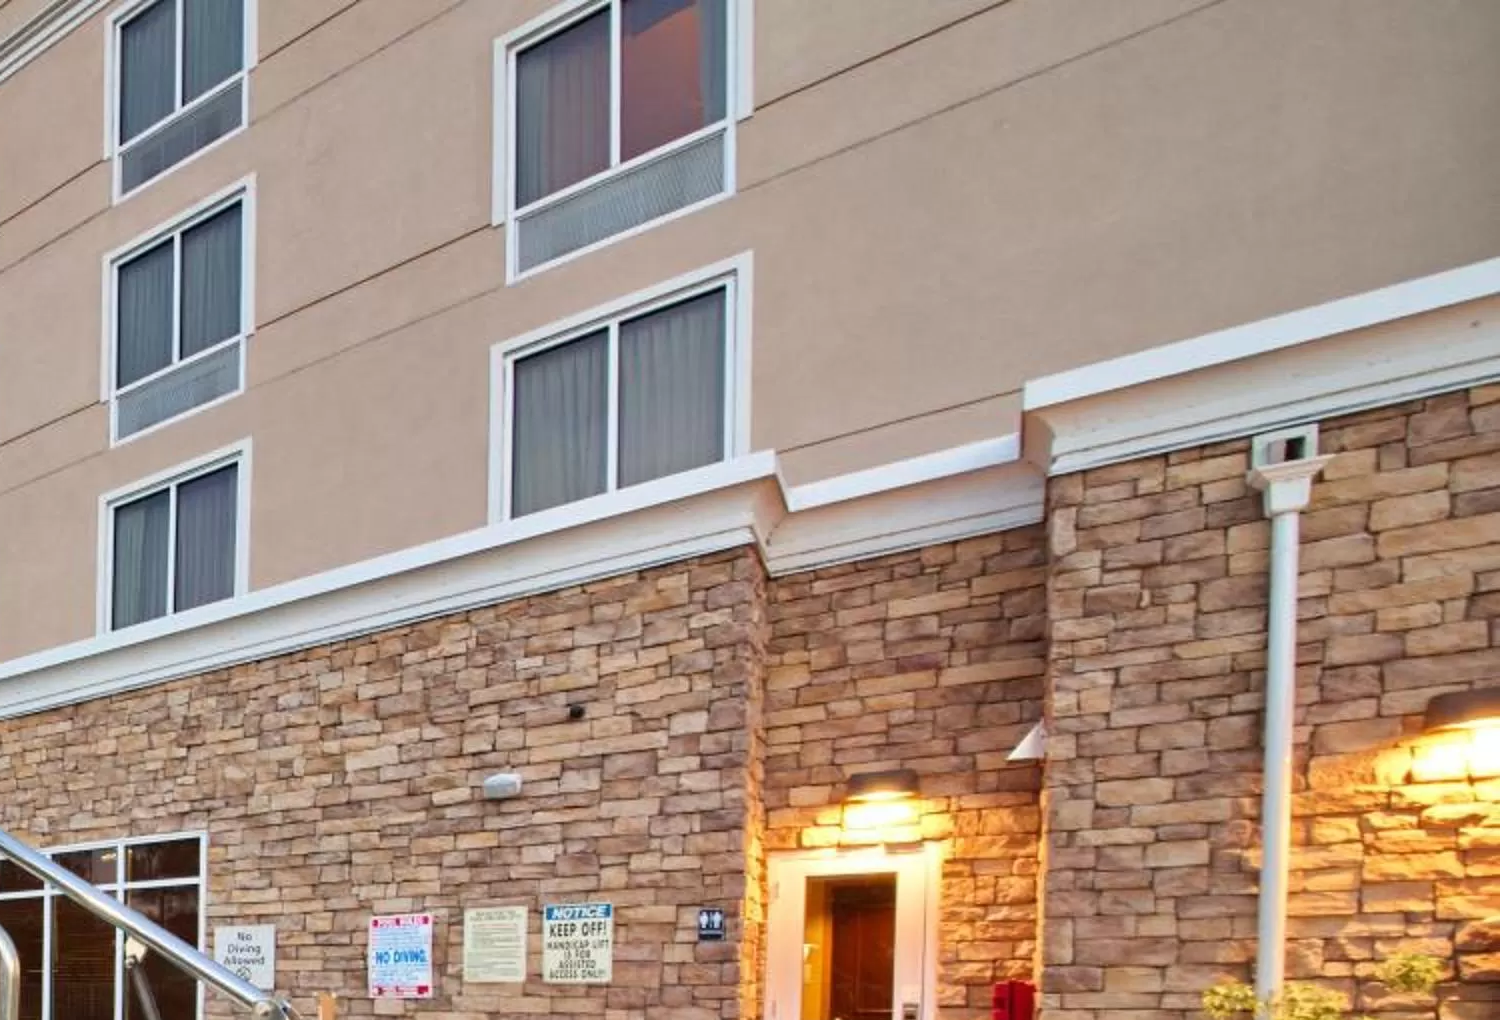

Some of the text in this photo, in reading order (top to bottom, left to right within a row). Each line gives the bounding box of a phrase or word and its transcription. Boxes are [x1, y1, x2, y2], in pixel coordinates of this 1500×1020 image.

[551, 905, 607, 919] NOTICE
[549, 920, 607, 937] KEEP OFF!
[237, 932, 253, 940] No
[227, 943, 261, 955] Diving
[547, 940, 590, 950] HANDICAP
[223, 956, 265, 965] Allowed
[375, 951, 390, 965] NO
[558, 960, 597, 969] ASSISTED
